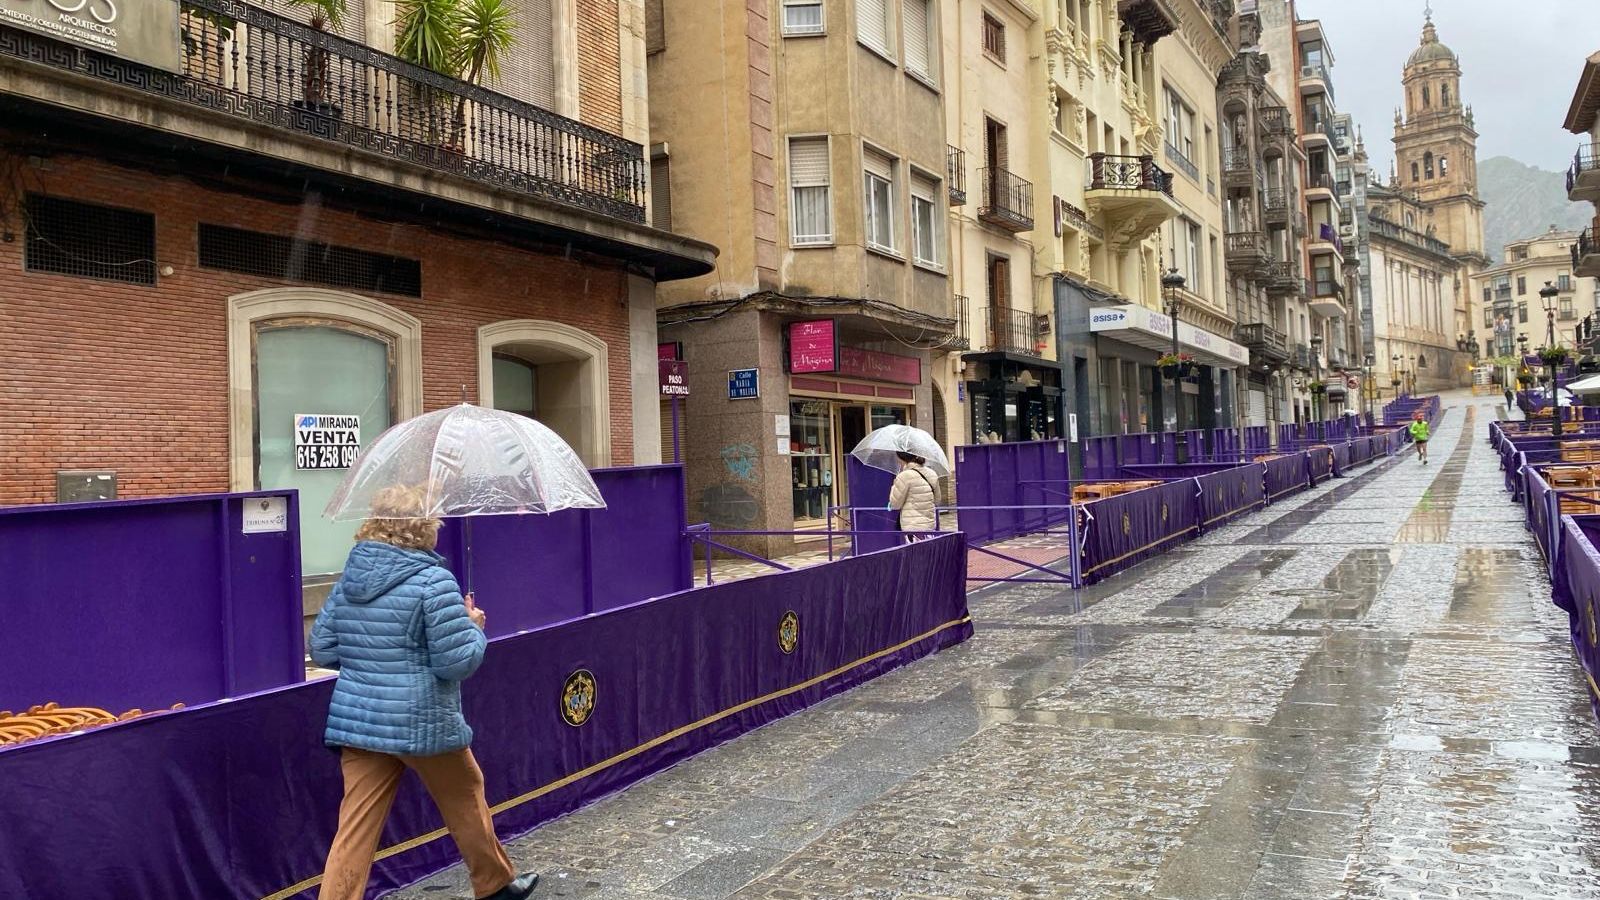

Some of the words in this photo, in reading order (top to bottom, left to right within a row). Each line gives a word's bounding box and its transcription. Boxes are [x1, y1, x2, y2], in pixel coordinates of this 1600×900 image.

[58, 13, 117, 37] ARQUITECTOS
[803, 324, 822, 335] Flor
[668, 374, 683, 384] PASO
[662, 385, 689, 395] PEATONAL
[319, 417, 359, 429] MIRANDA
[299, 431, 357, 443] VENTA
[297, 446, 317, 468] 615
[319, 446, 339, 468] 258
